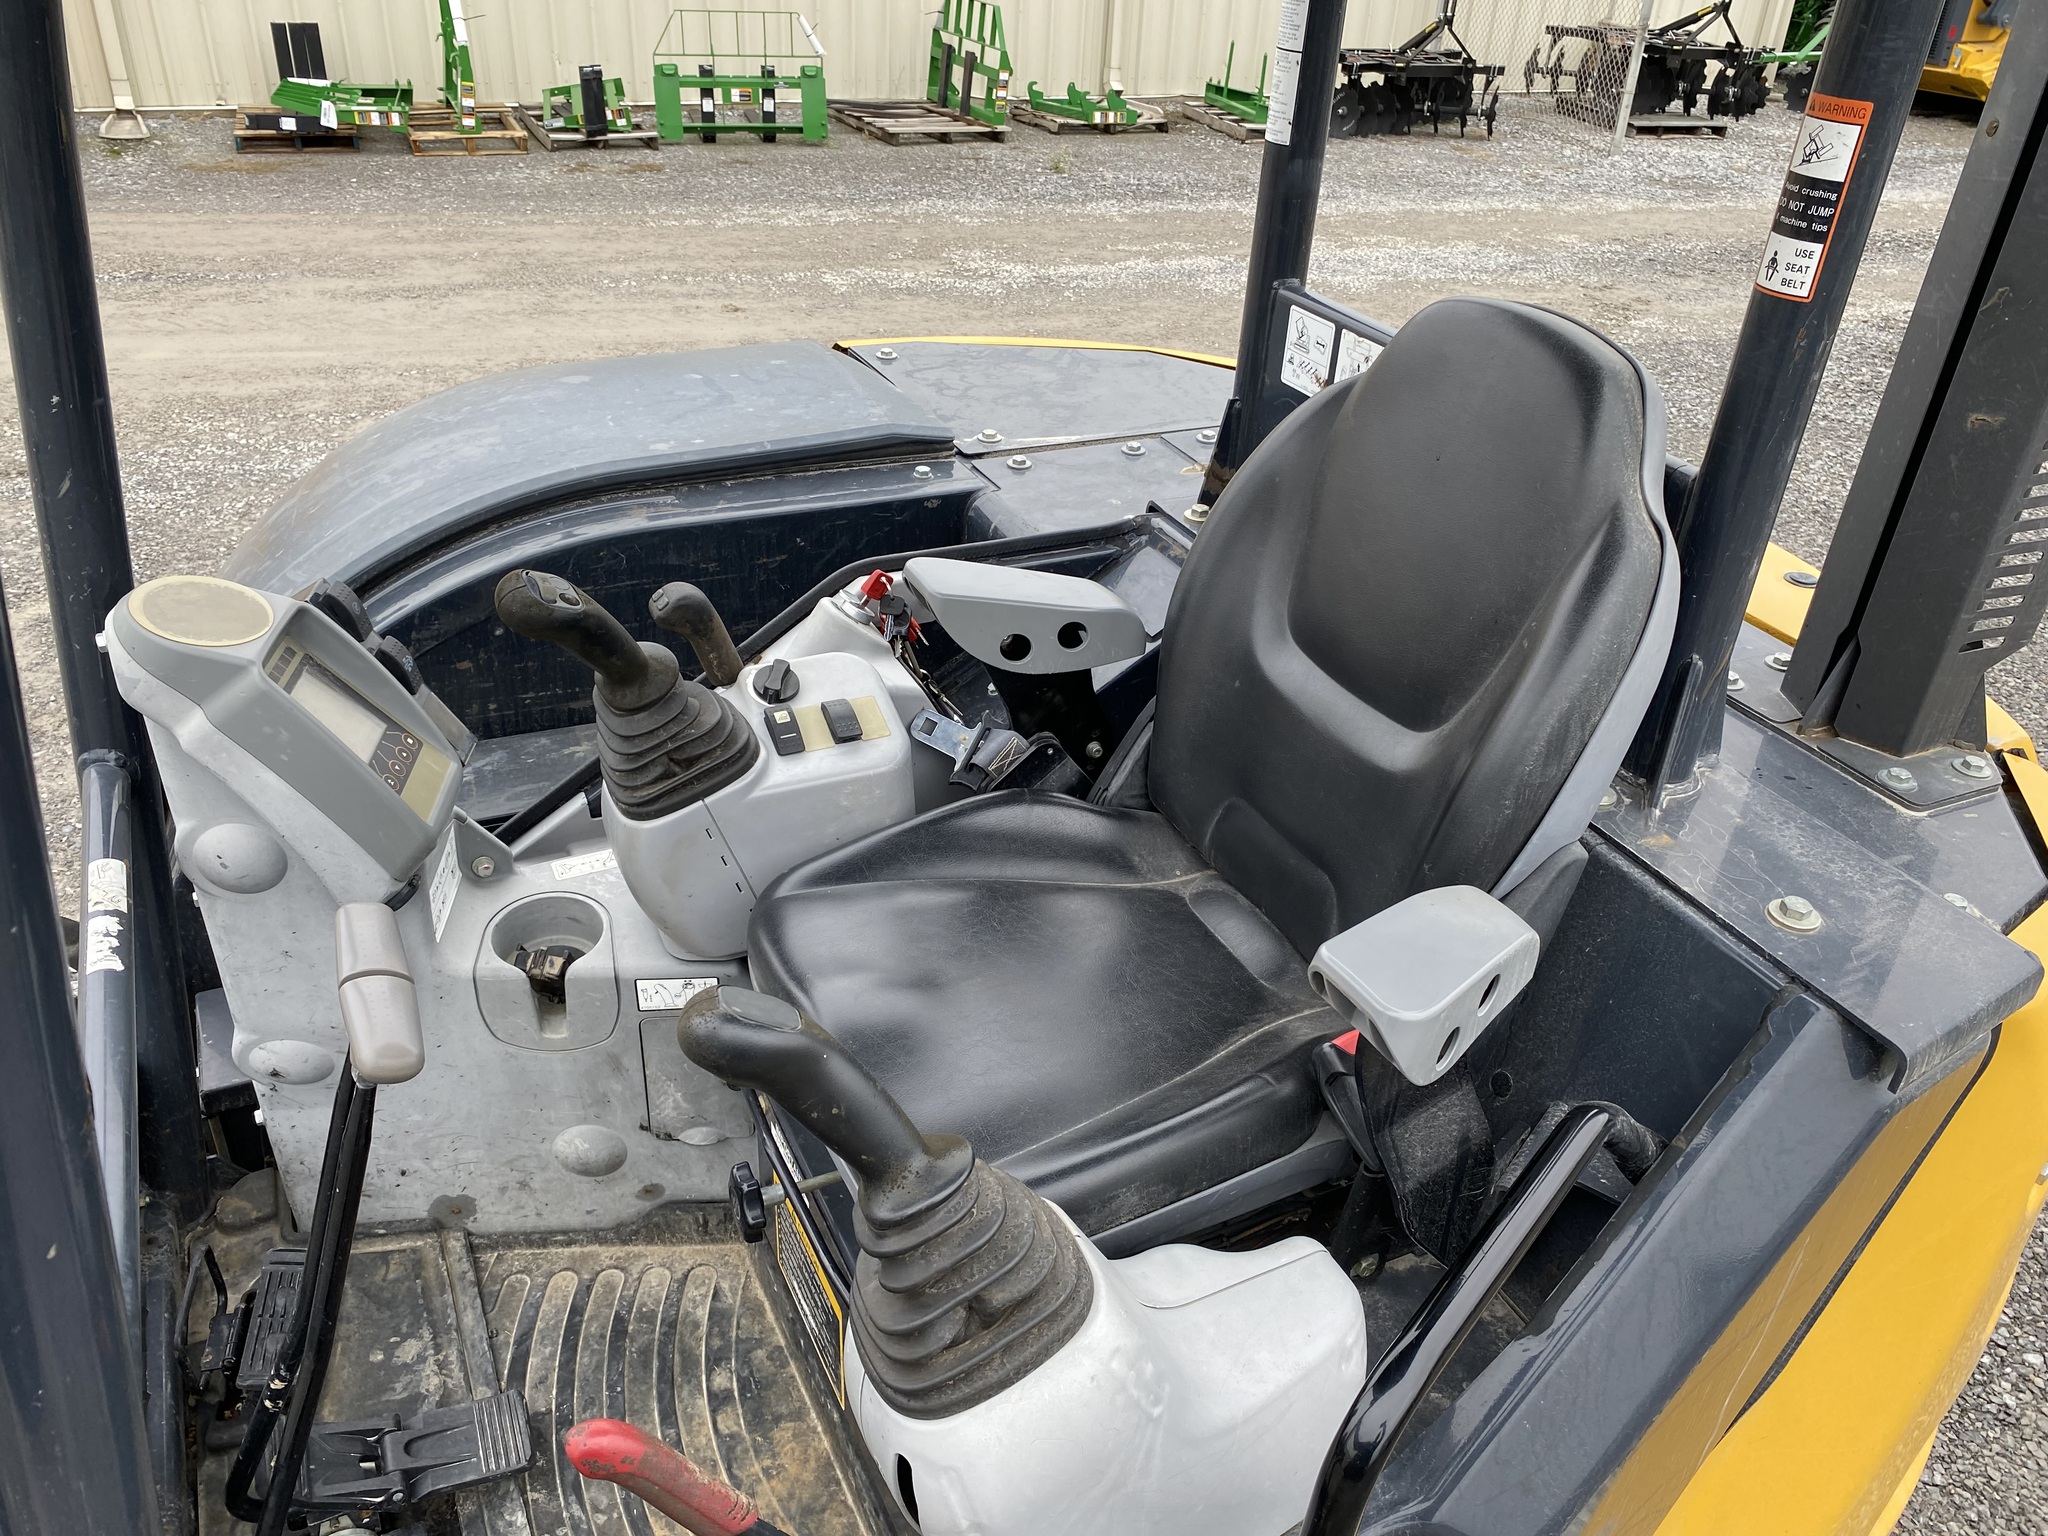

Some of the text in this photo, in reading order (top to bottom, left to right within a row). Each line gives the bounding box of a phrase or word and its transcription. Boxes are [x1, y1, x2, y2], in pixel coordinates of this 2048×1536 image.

[1818, 103, 1867, 120] WARNING
[1801, 187, 1838, 201] crushing
[1788, 199, 1805, 212] NOT
[1807, 205, 1835, 218] JUMP
[1780, 215, 1808, 228] machine
[1811, 222, 1828, 232] tips
[1794, 247, 1815, 260] USE
[1784, 262, 1810, 275] SEAT
[1780, 277, 1806, 290] BELT
